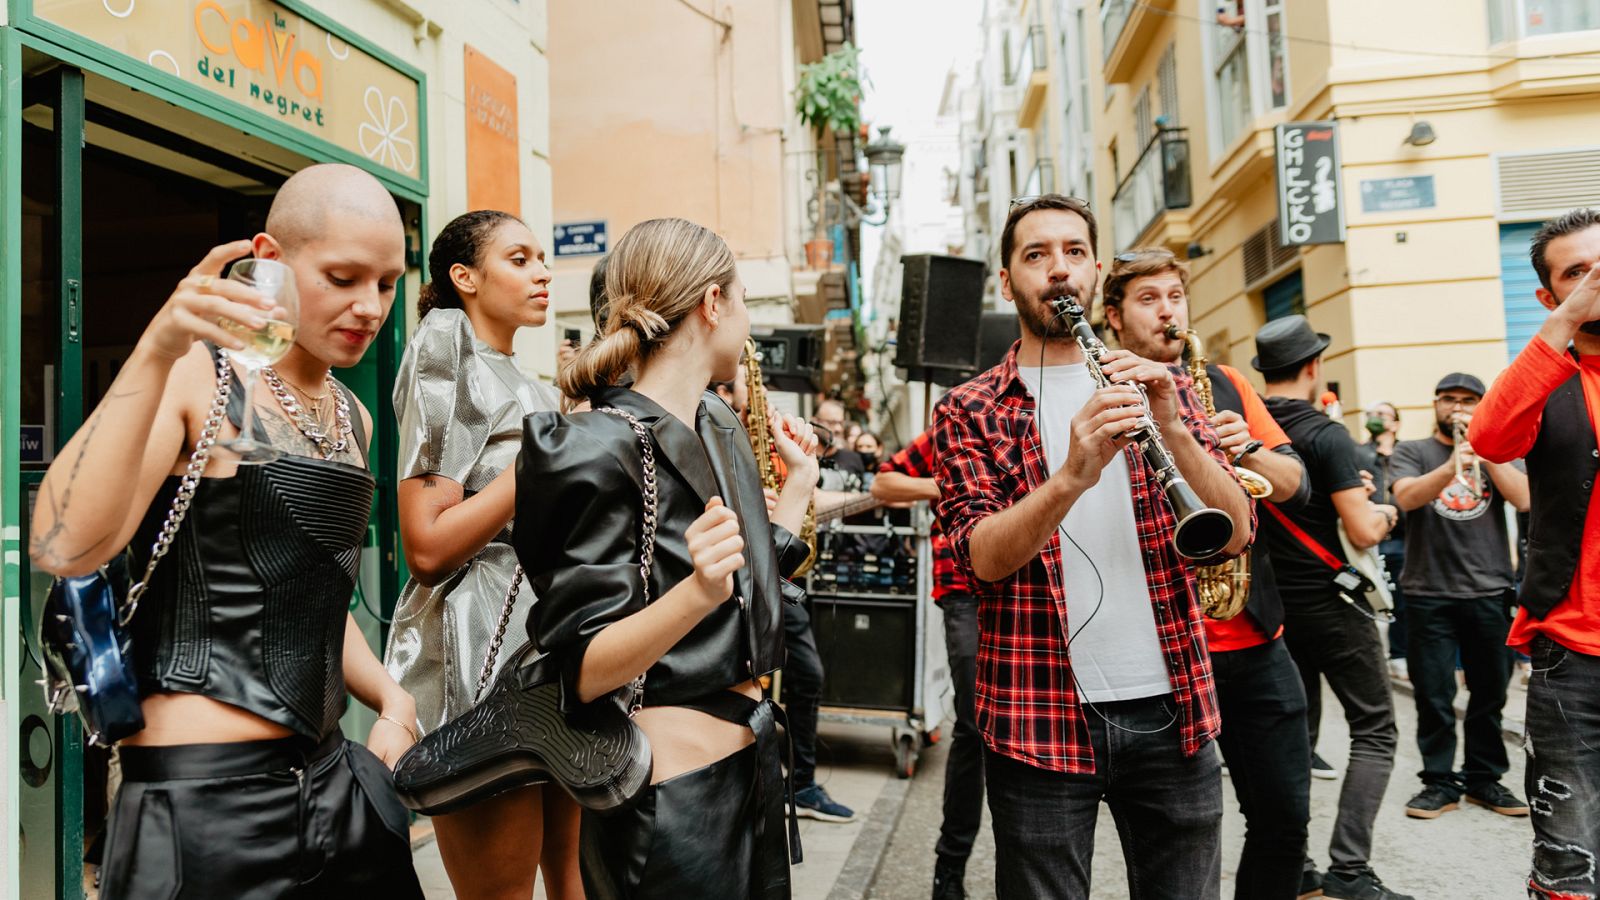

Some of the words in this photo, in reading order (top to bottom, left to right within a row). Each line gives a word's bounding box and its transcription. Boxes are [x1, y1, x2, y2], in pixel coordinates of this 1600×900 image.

[197, 56, 236, 89] del
[250, 82, 325, 127] negret
[1284, 128, 1317, 243] GHECKO
